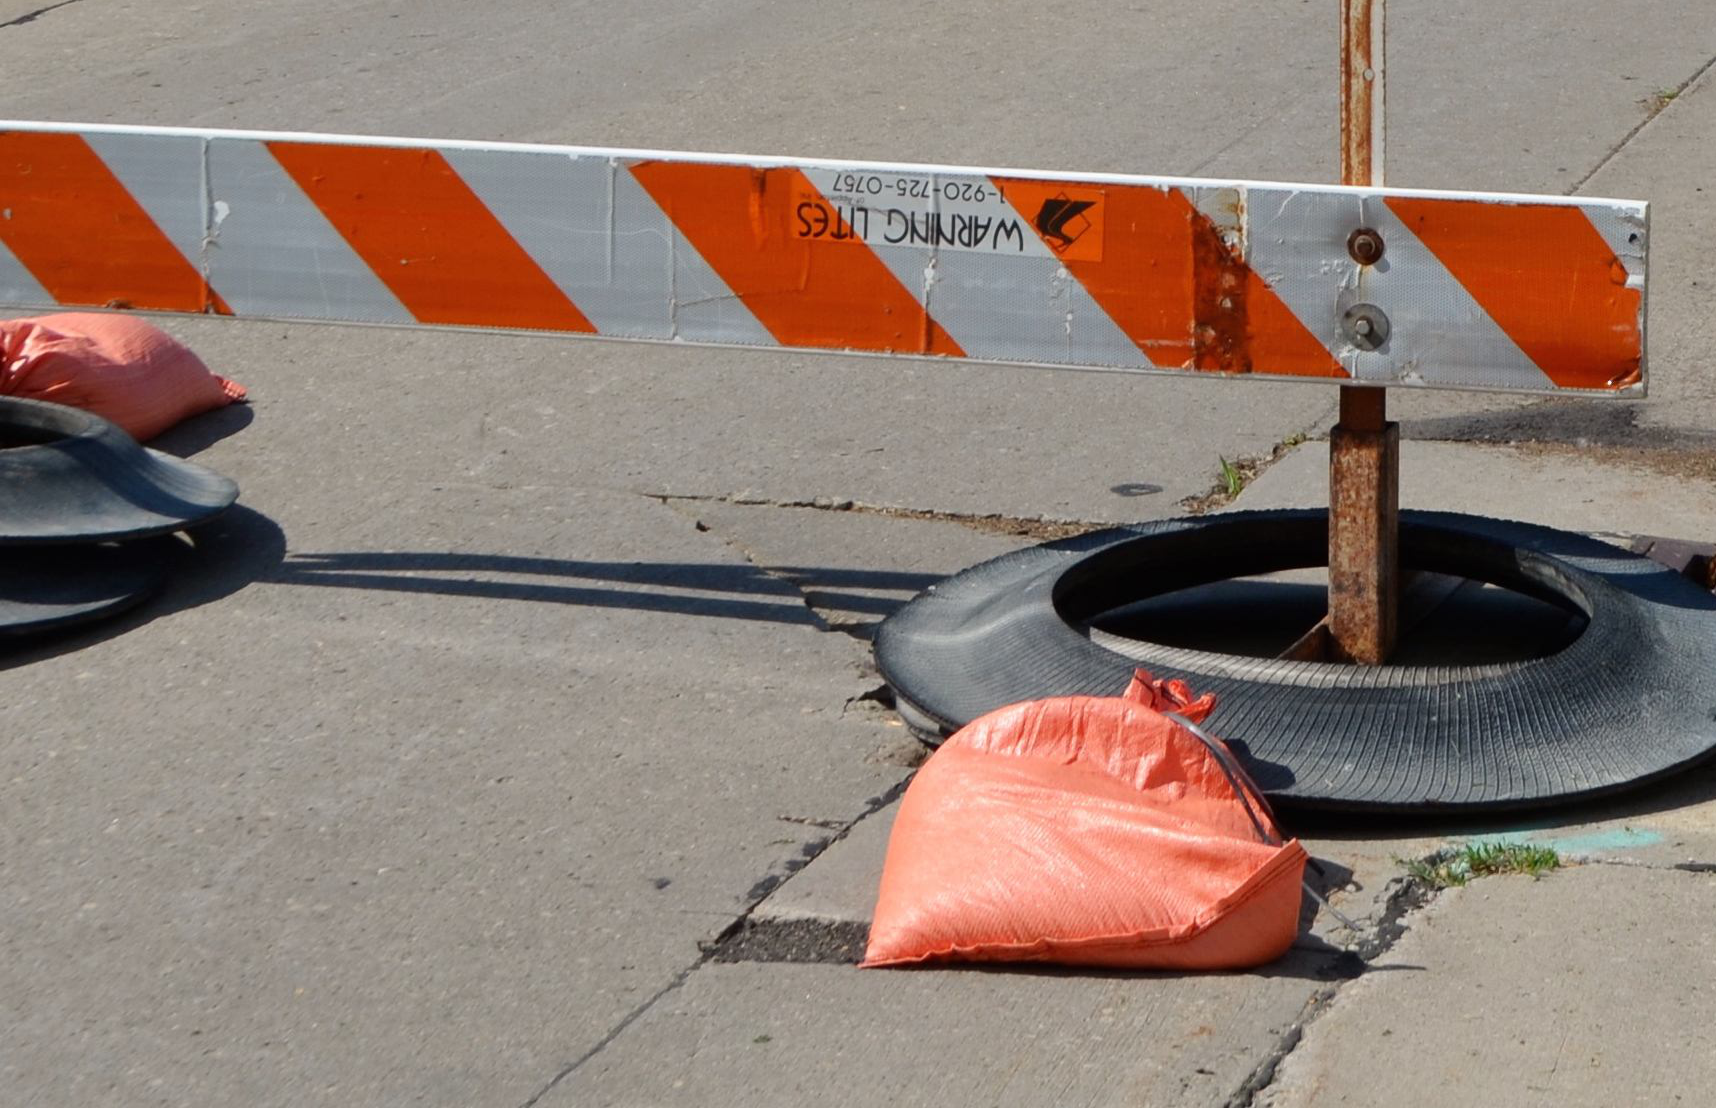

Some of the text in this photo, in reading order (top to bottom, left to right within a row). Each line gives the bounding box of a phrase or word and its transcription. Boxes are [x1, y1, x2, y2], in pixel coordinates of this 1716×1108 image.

[833, 173, 1006, 205] 1-920-725-0757
[797, 203, 1024, 252] WARNING LITES
